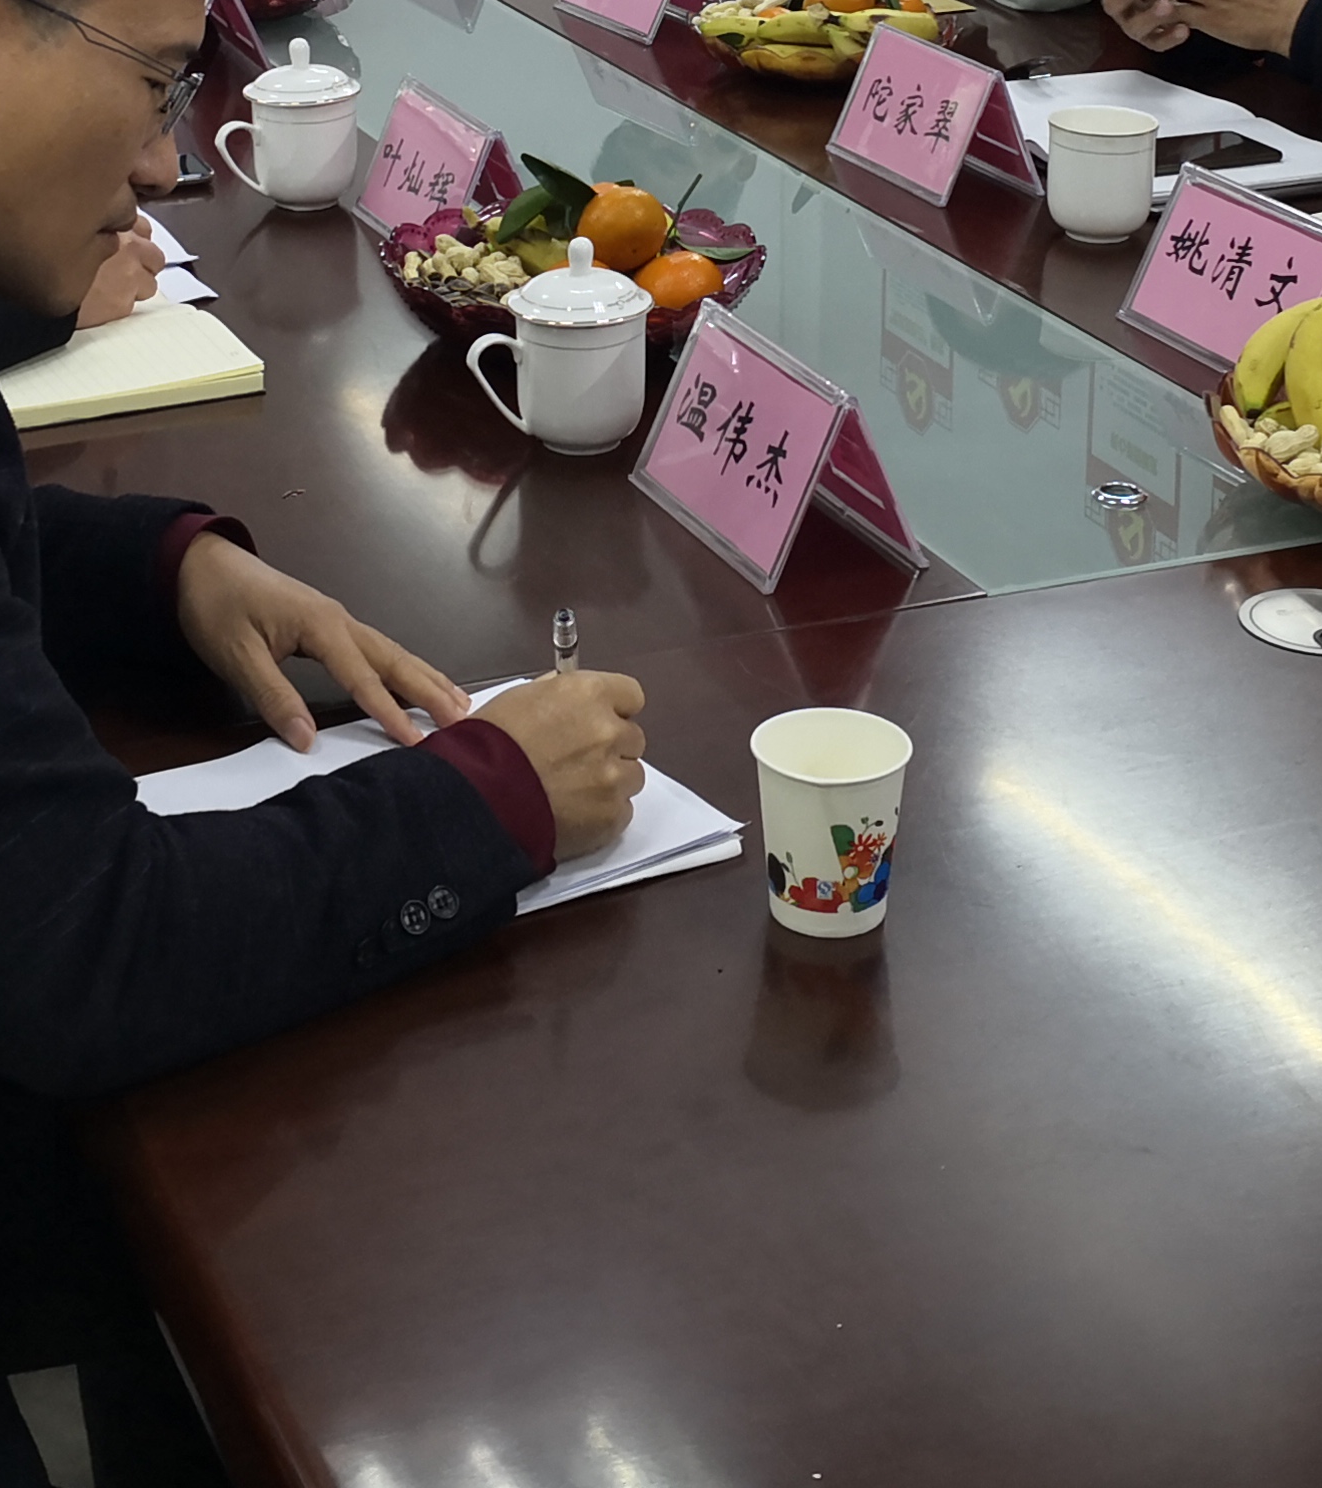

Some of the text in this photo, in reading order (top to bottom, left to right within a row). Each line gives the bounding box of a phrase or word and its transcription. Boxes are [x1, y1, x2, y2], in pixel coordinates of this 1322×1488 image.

[1165, 219, 1298, 314] 姚清文
[677, 373, 790, 509] 温伟杰
